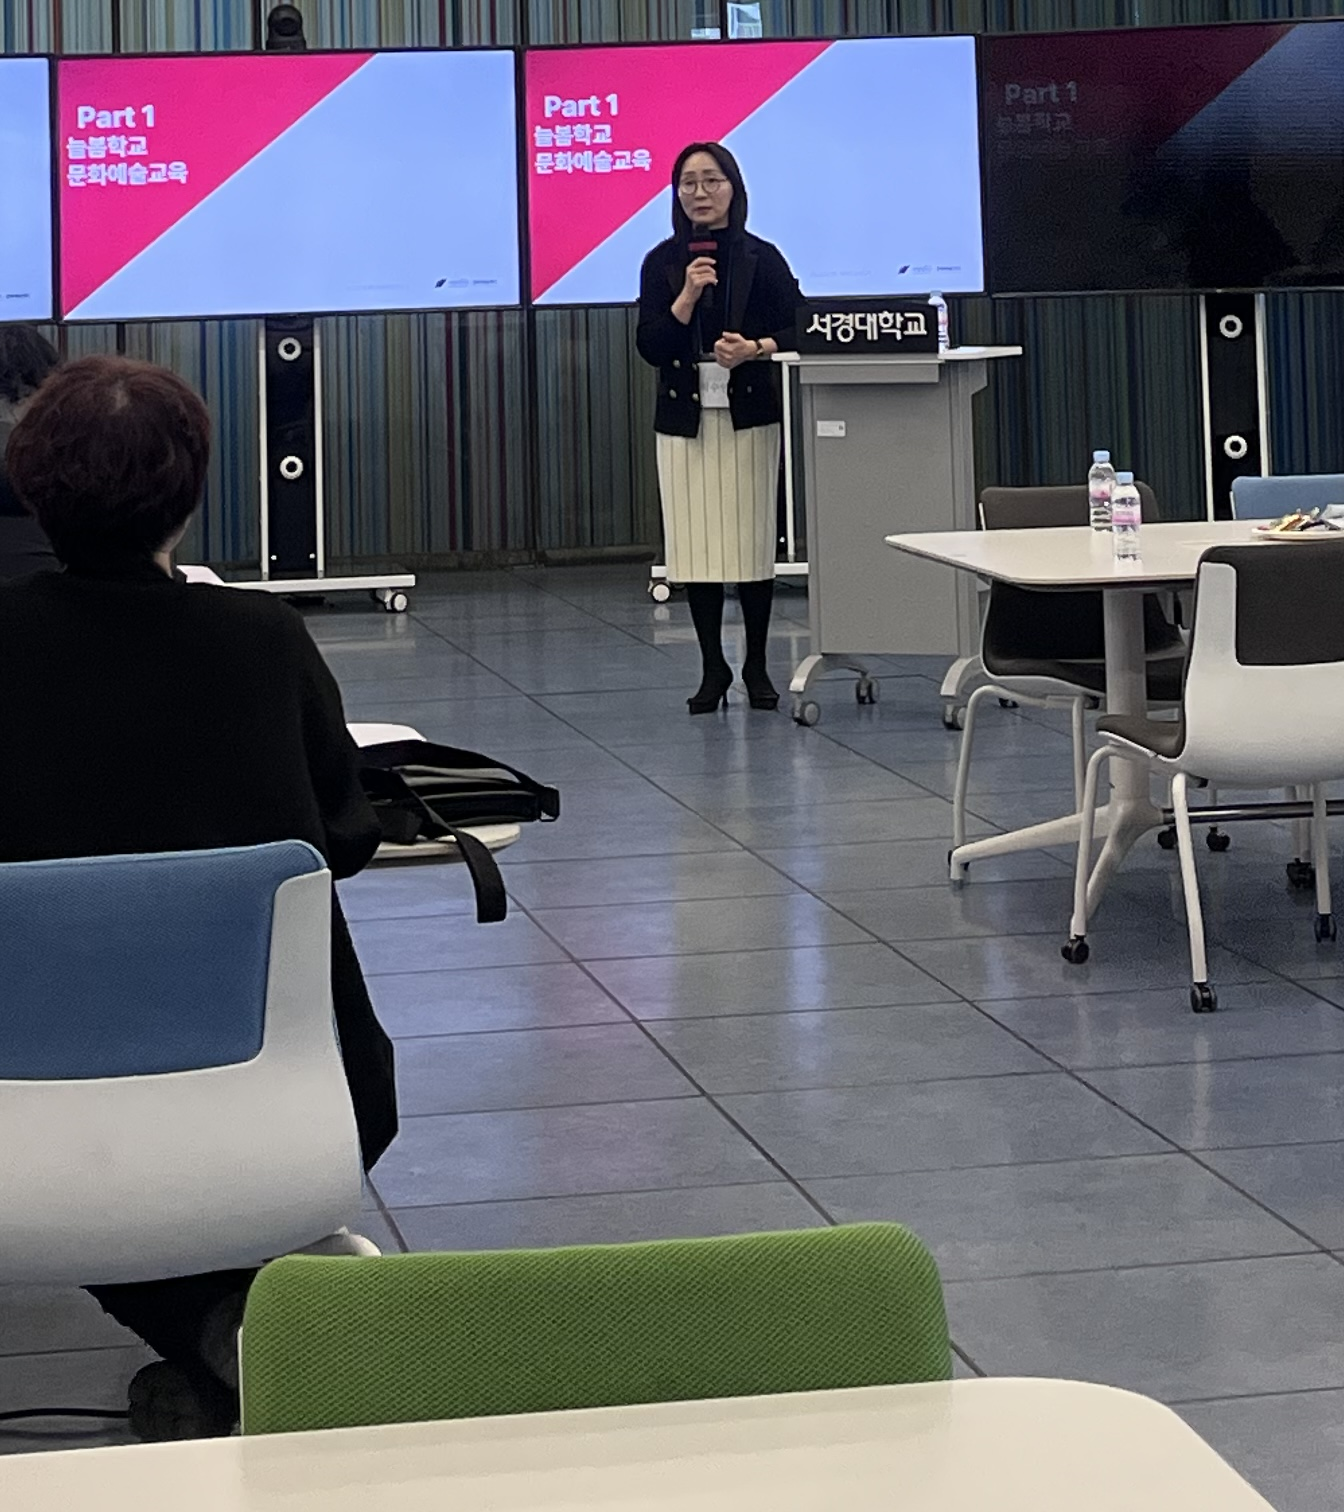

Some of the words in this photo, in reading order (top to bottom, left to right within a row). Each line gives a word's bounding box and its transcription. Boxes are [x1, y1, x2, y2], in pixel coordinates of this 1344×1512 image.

[544, 95, 601, 118] Part
[605, 93, 618, 116] 1
[1004, 82, 1061, 106] Part
[78, 105, 137, 129] Part
[141, 104, 155, 128] 1
[66, 135, 149, 160] 늘봄학교
[534, 123, 613, 148] 늘봄학교
[67, 161, 189, 187] 문화예술교육
[535, 149, 653, 175] 문화예술교육
[806, 311, 928, 343] 서경대학교
